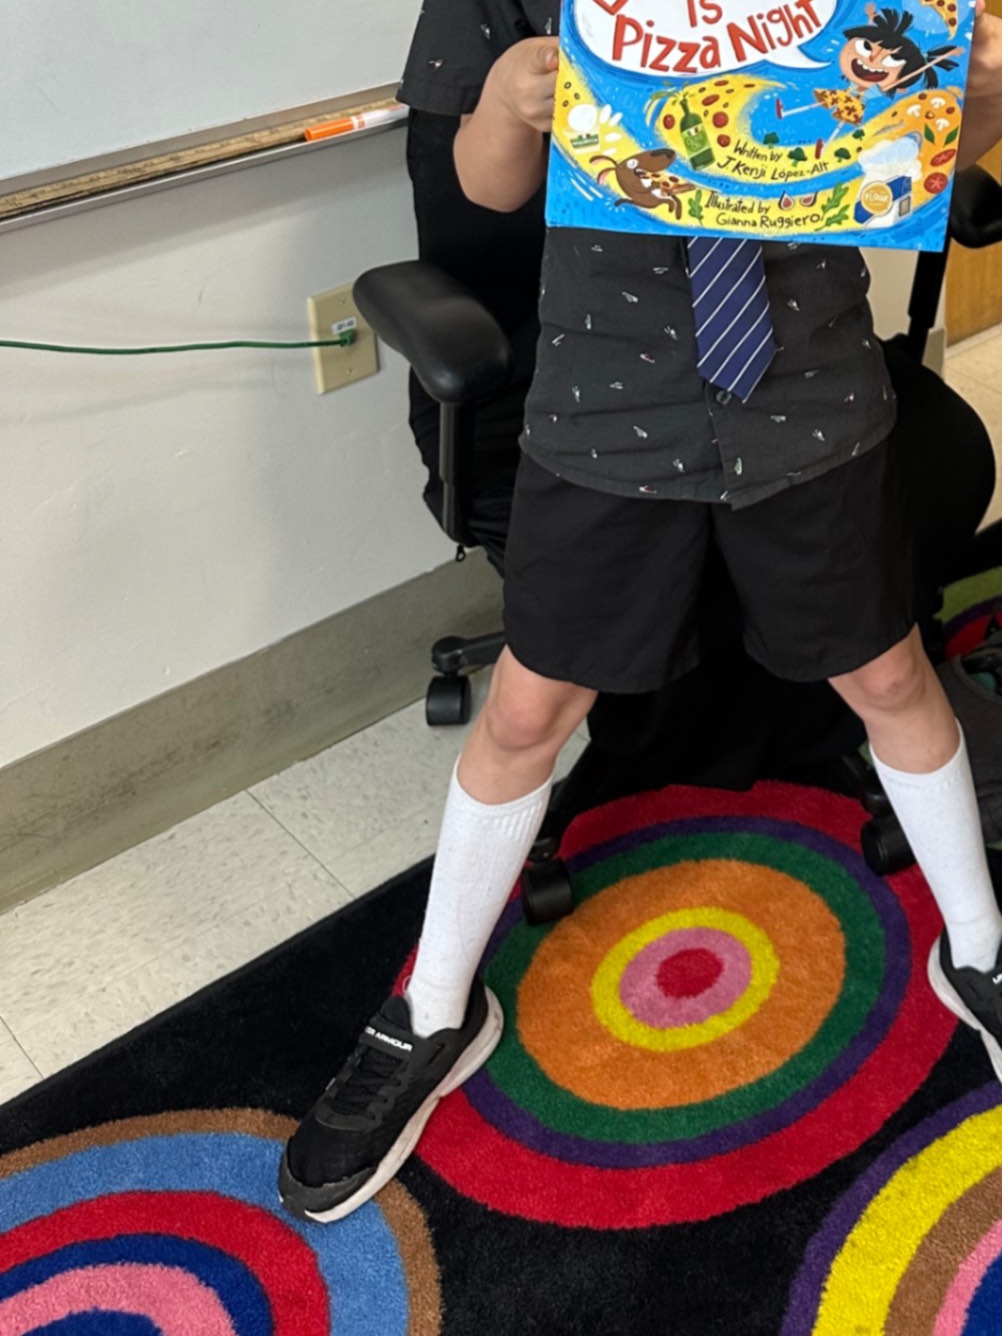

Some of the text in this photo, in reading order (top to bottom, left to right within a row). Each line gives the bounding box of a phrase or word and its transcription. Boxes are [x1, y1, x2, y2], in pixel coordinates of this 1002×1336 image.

[733, 139, 783, 163] Written by
[732, 160, 767, 180] Kenji
[704, 190, 771, 216] Illustrated by
[716, 212, 821, 229] Gianna Ruggiero
